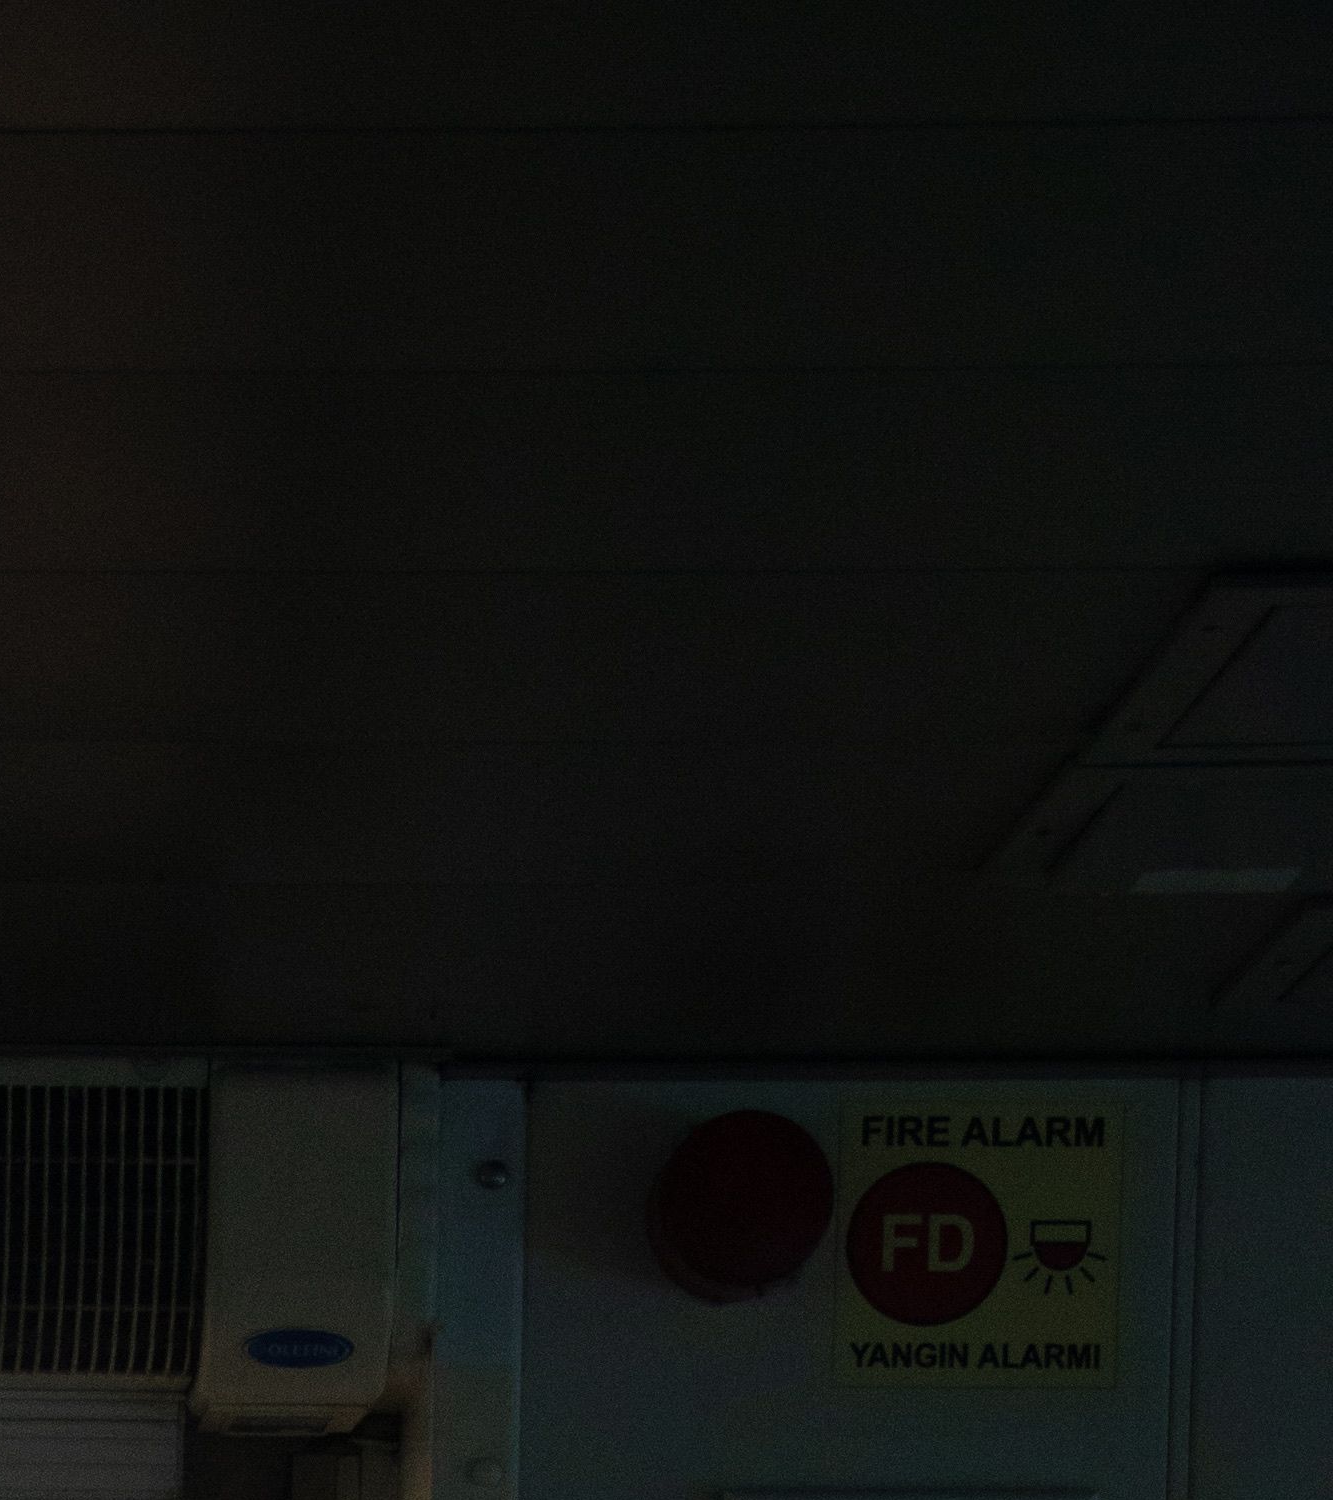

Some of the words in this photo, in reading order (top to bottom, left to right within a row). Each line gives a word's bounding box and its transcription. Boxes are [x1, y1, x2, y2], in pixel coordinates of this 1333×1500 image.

[862, 1116, 950, 1146] FIRE
[962, 1117, 1105, 1148] ALARM
[881, 1214, 974, 1273] FD
[850, 1341, 969, 1369] YANGIN
[978, 1342, 1101, 1371] ALARMI
